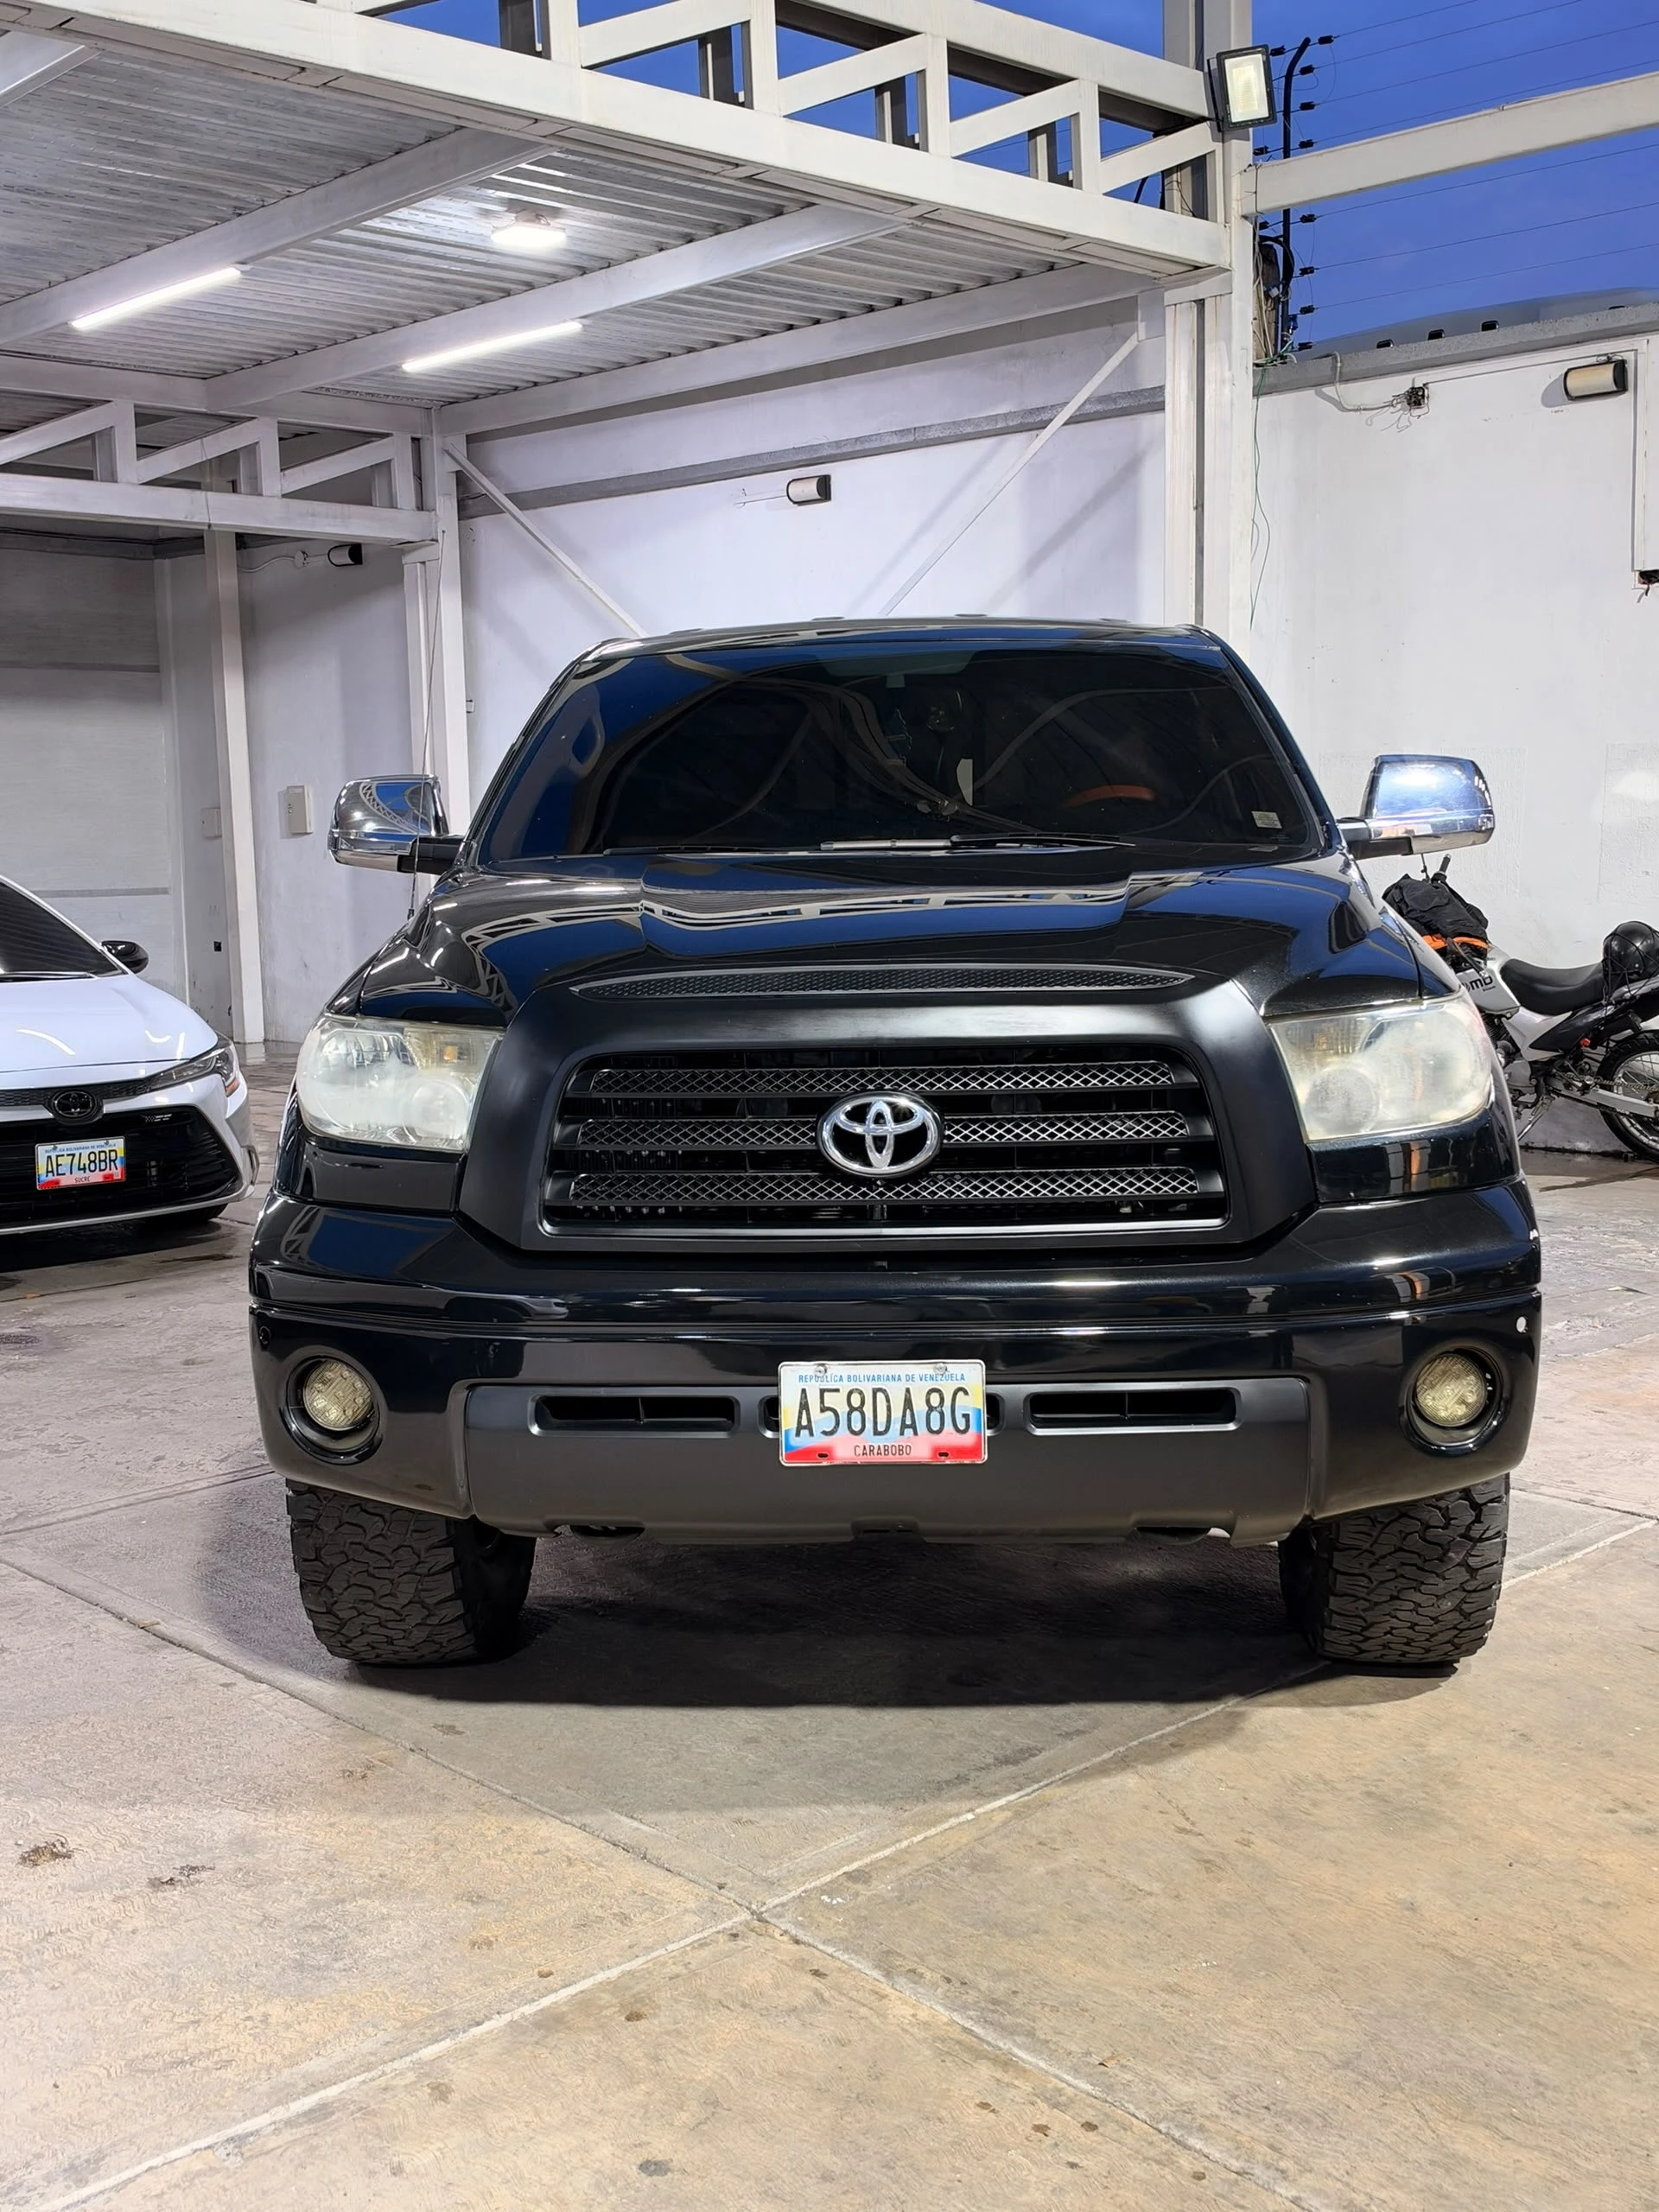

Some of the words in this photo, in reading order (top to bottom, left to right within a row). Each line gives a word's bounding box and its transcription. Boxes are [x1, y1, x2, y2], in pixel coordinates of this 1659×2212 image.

[45, 1149, 118, 1178] AE748BR
[847, 1374, 902, 1382] BOLIVARIANA
[905, 1373, 916, 1382] DE
[918, 1373, 966, 1382] VENEZUELA
[794, 1386, 971, 1438] A58DA8G
[854, 1444, 912, 1456] CARABOBO
